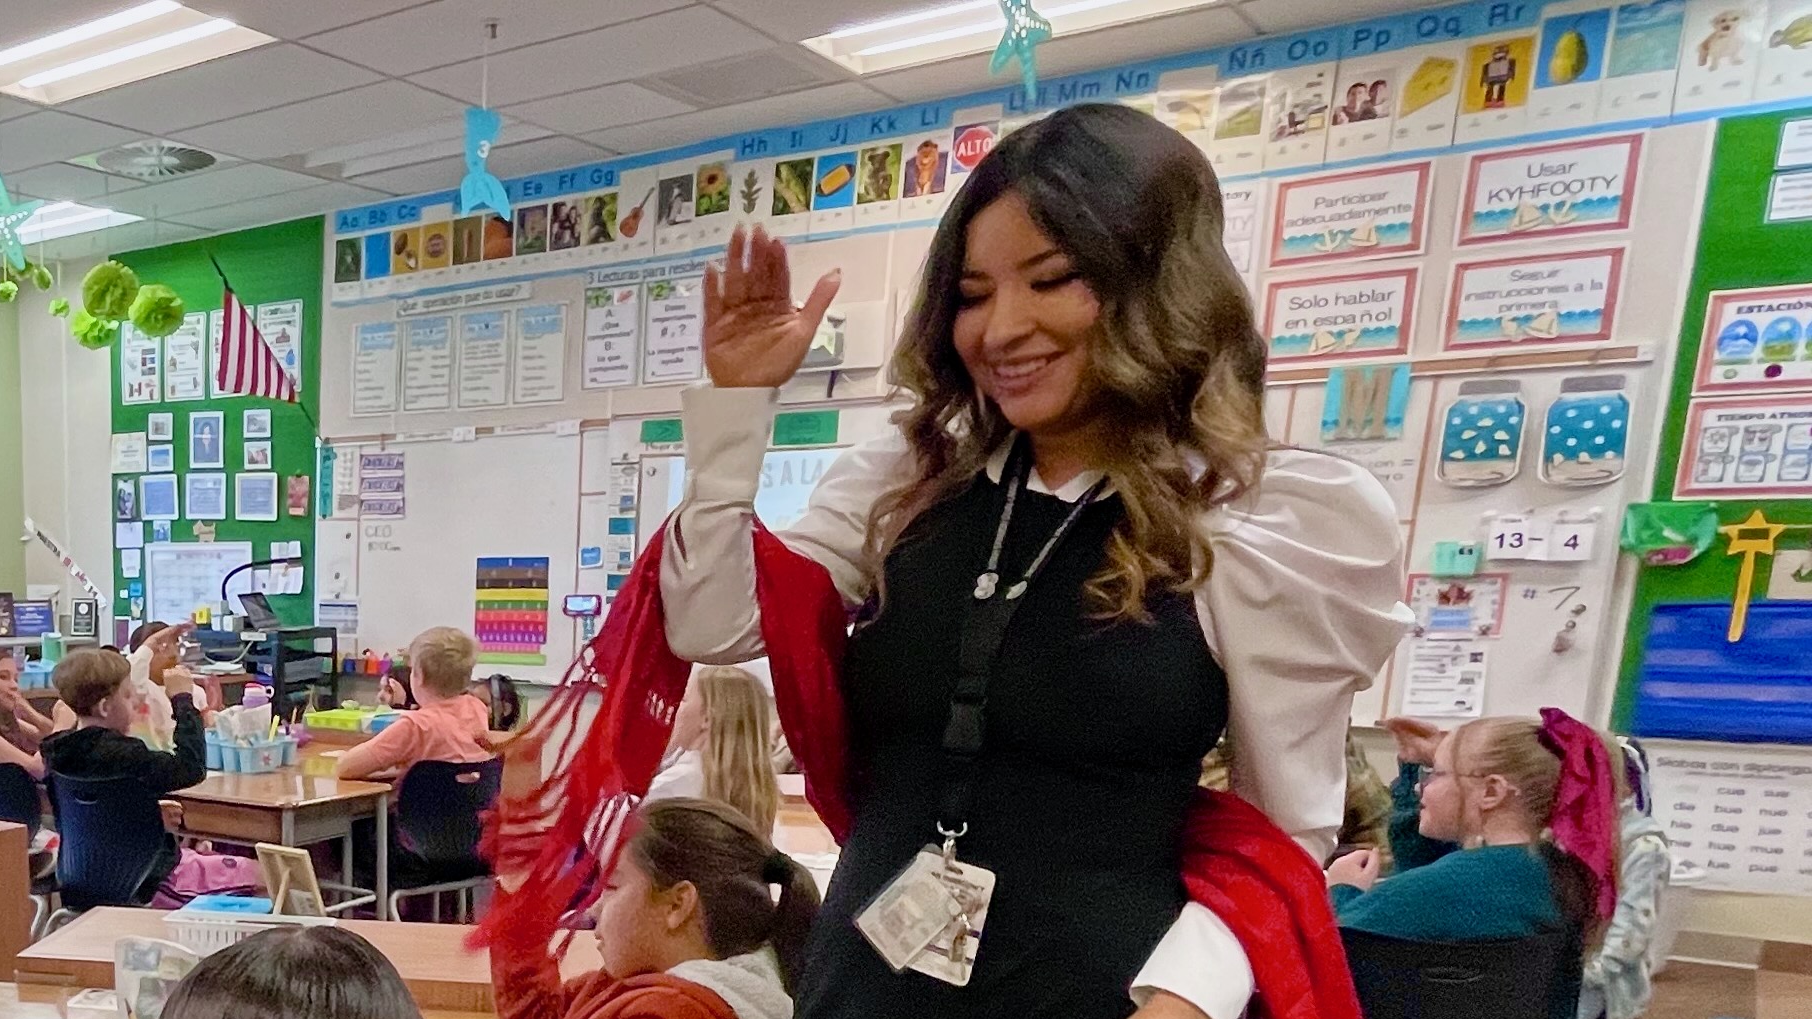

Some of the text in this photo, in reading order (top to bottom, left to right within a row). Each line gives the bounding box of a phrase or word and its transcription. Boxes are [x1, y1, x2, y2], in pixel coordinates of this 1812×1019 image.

[369, 210, 387, 225] Bb
[398, 204, 418, 219] Cc
[523, 180, 543, 196] Ee
[558, 173, 578, 189] Ff
[590, 167, 615, 186] Gg
[741, 136, 767, 156] Hh
[829, 125, 848, 145] Jj
[871, 116, 897, 135] Kk
[1115, 69, 1150, 91] Nn
[1228, 46, 1266, 71] Ññ
[1287, 39, 1329, 61] Oo
[1353, 28, 1390, 50] Pp
[956, 139, 993, 159] ALTO
[1527, 162, 1578, 179] Usar
[1488, 174, 1619, 204] KYHFOOTY
[1314, 191, 1390, 210] Participar
[1286, 204, 1413, 228] adecuadamente
[1591, 279, 1604, 291] la
[1289, 289, 1397, 311] Solo hablar
[1285, 307, 1393, 330] en español
[1494, 532, 1524, 549] 13
[1563, 534, 1580, 551] 4
